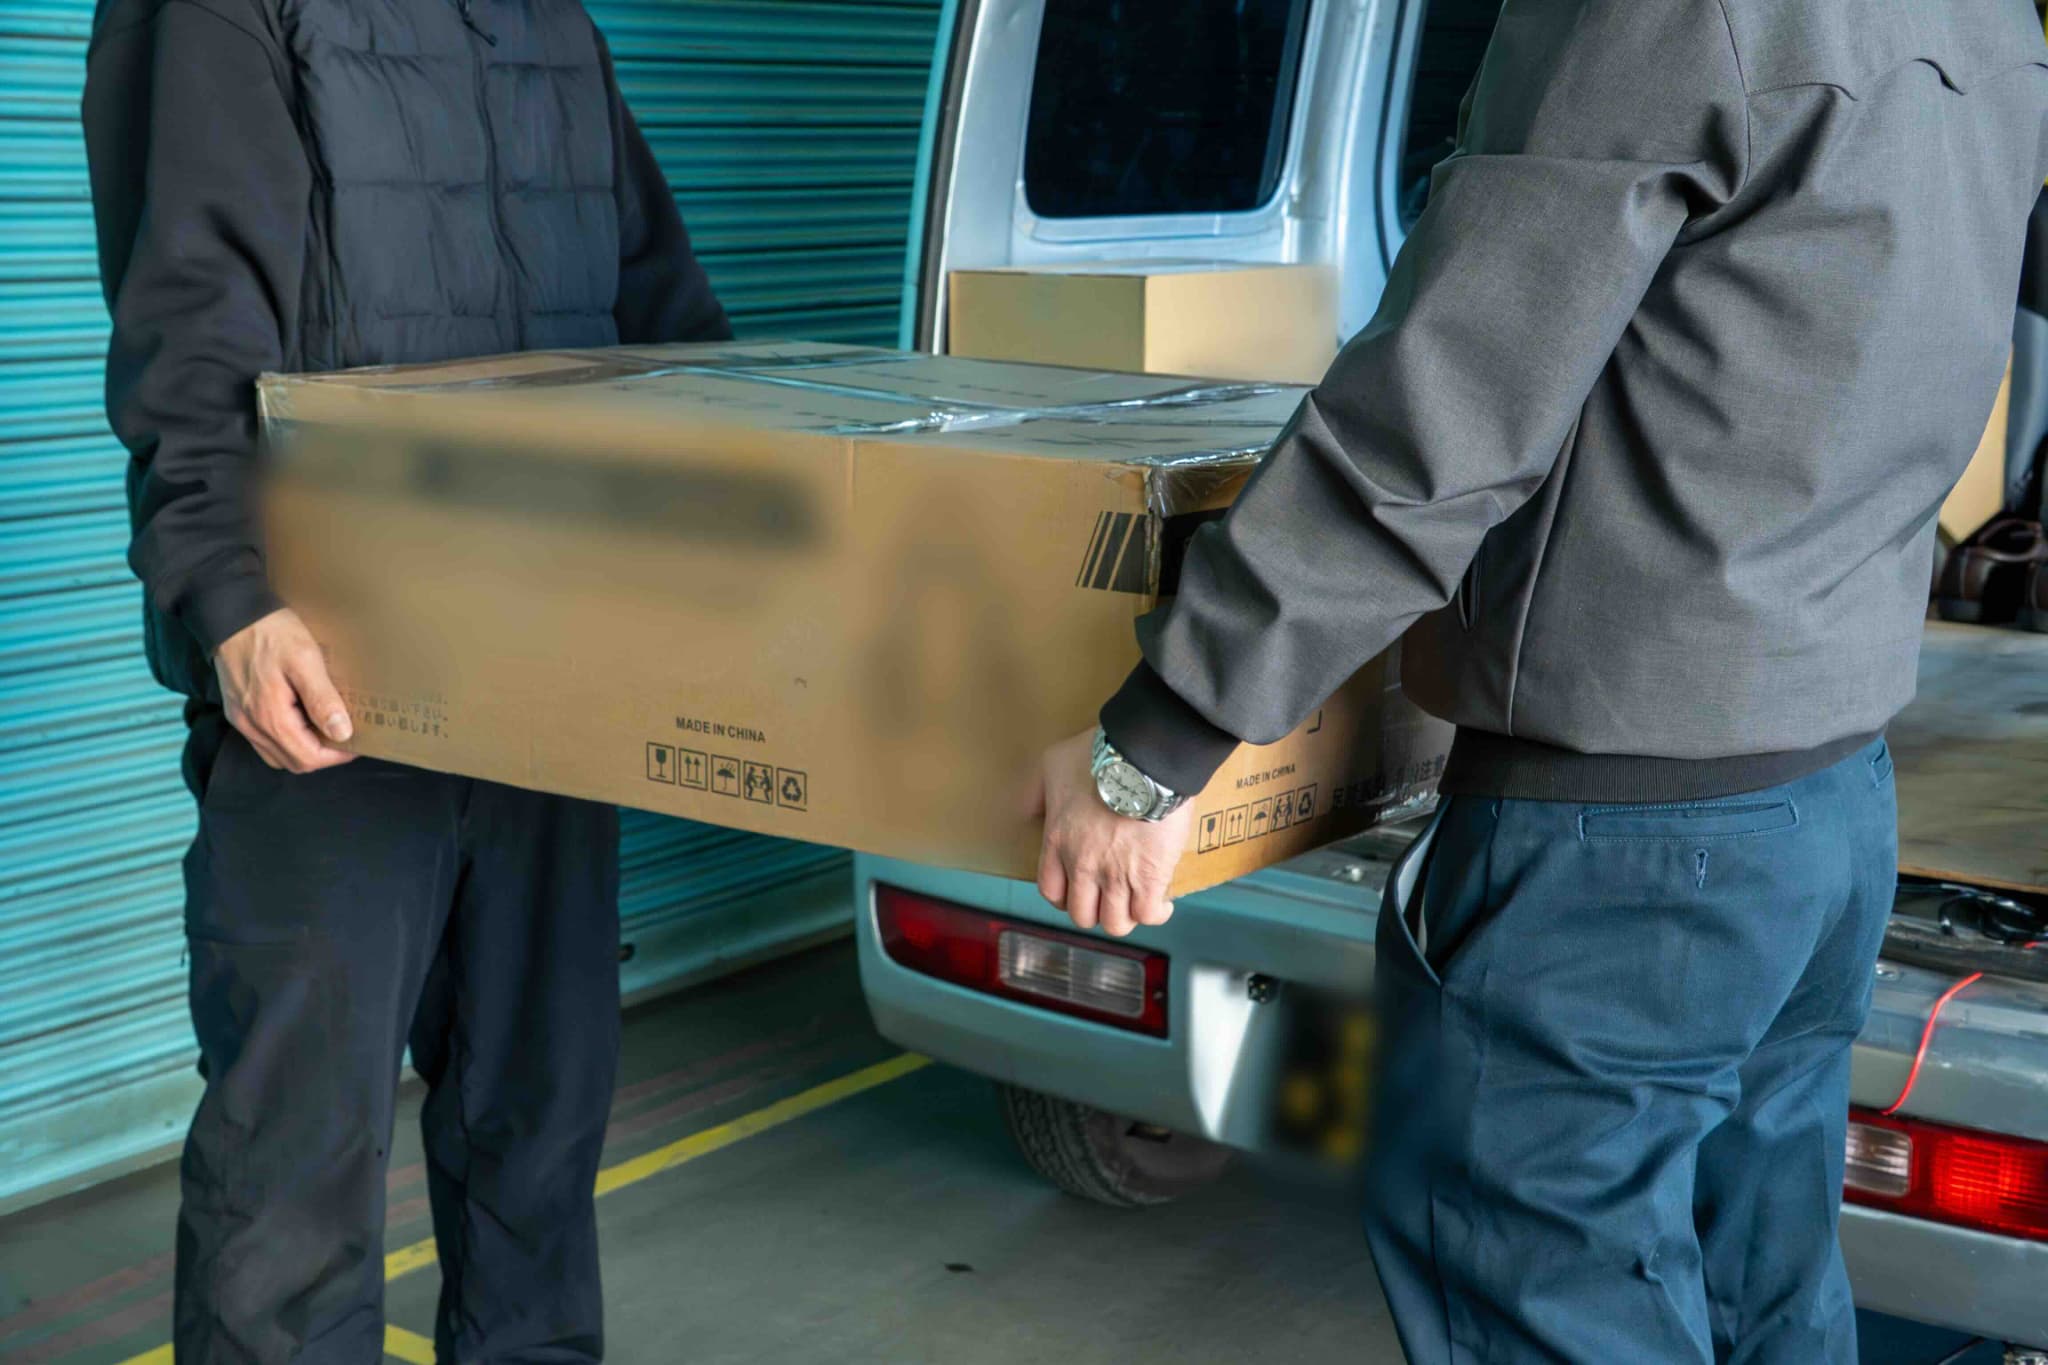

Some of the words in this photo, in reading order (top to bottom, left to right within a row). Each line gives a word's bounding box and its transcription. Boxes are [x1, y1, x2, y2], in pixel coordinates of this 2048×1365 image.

[676, 716, 710, 734] MADE
[713, 722, 725, 736] IN
[728, 725, 766, 743] CHINA
[1236, 773, 1260, 788] MADE
[1262, 770, 1271, 782] IN
[1271, 763, 1295, 780] CHINA
